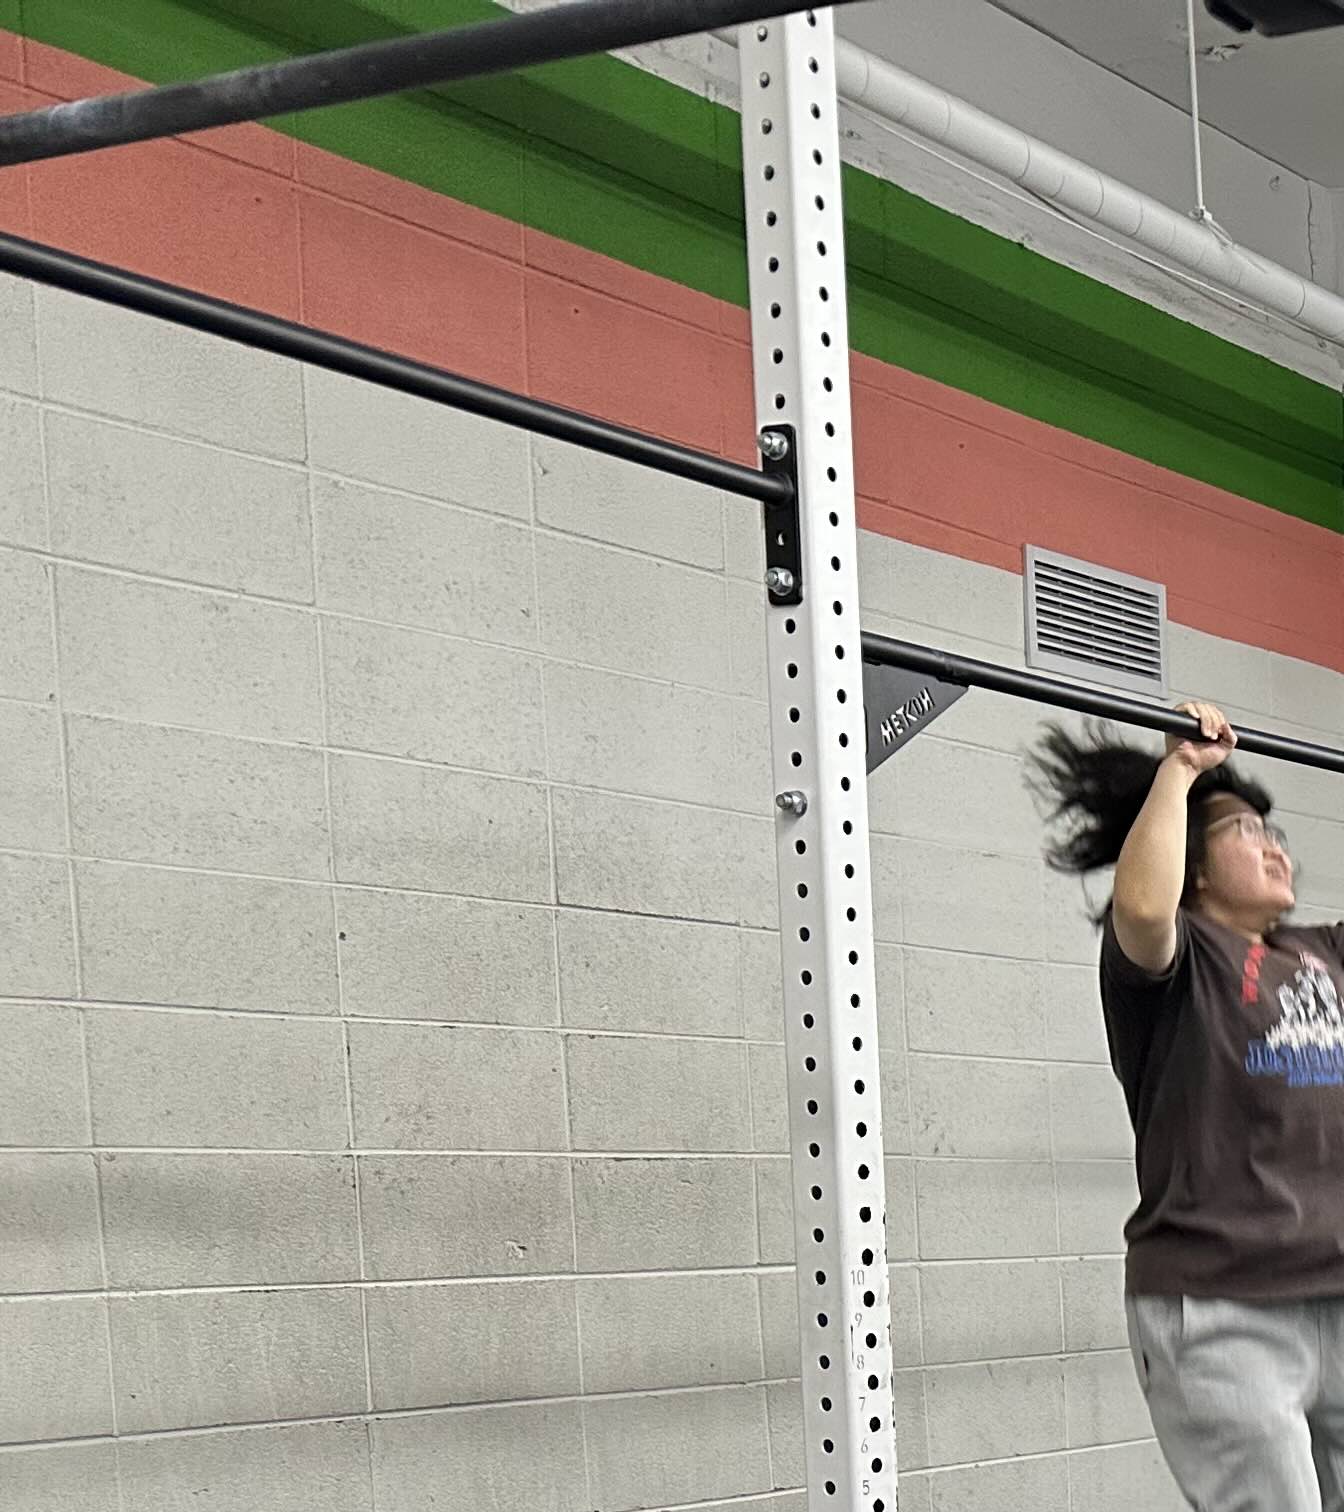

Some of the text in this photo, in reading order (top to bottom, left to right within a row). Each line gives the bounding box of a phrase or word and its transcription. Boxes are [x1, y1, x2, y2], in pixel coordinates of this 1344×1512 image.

[850, 1269, 865, 1285] 10
[854, 1312, 862, 1328] 9
[856, 1354, 864, 1370] 8
[860, 1438, 869, 1453] 6
[862, 1479, 870, 1495] 5
